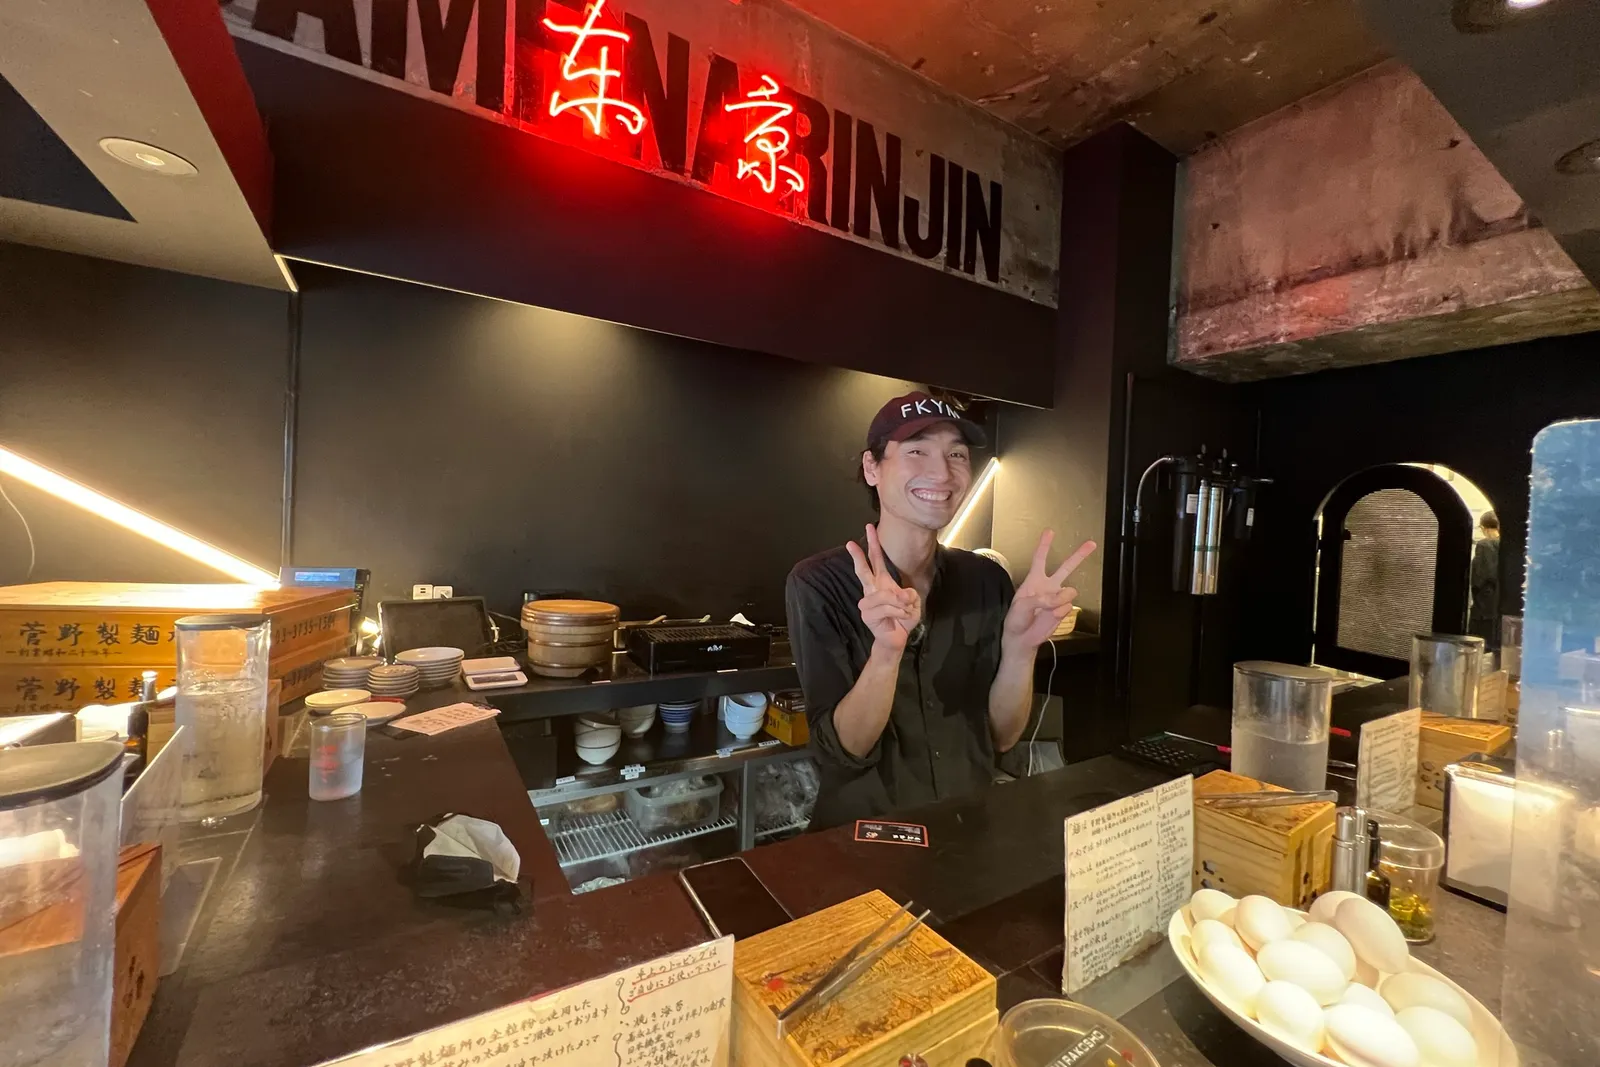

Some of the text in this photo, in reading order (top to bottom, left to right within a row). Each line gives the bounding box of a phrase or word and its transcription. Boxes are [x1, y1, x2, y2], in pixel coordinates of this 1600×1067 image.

[20, 621, 175, 646] 菅野製麺
[16, 676, 176, 701] 菅野製
